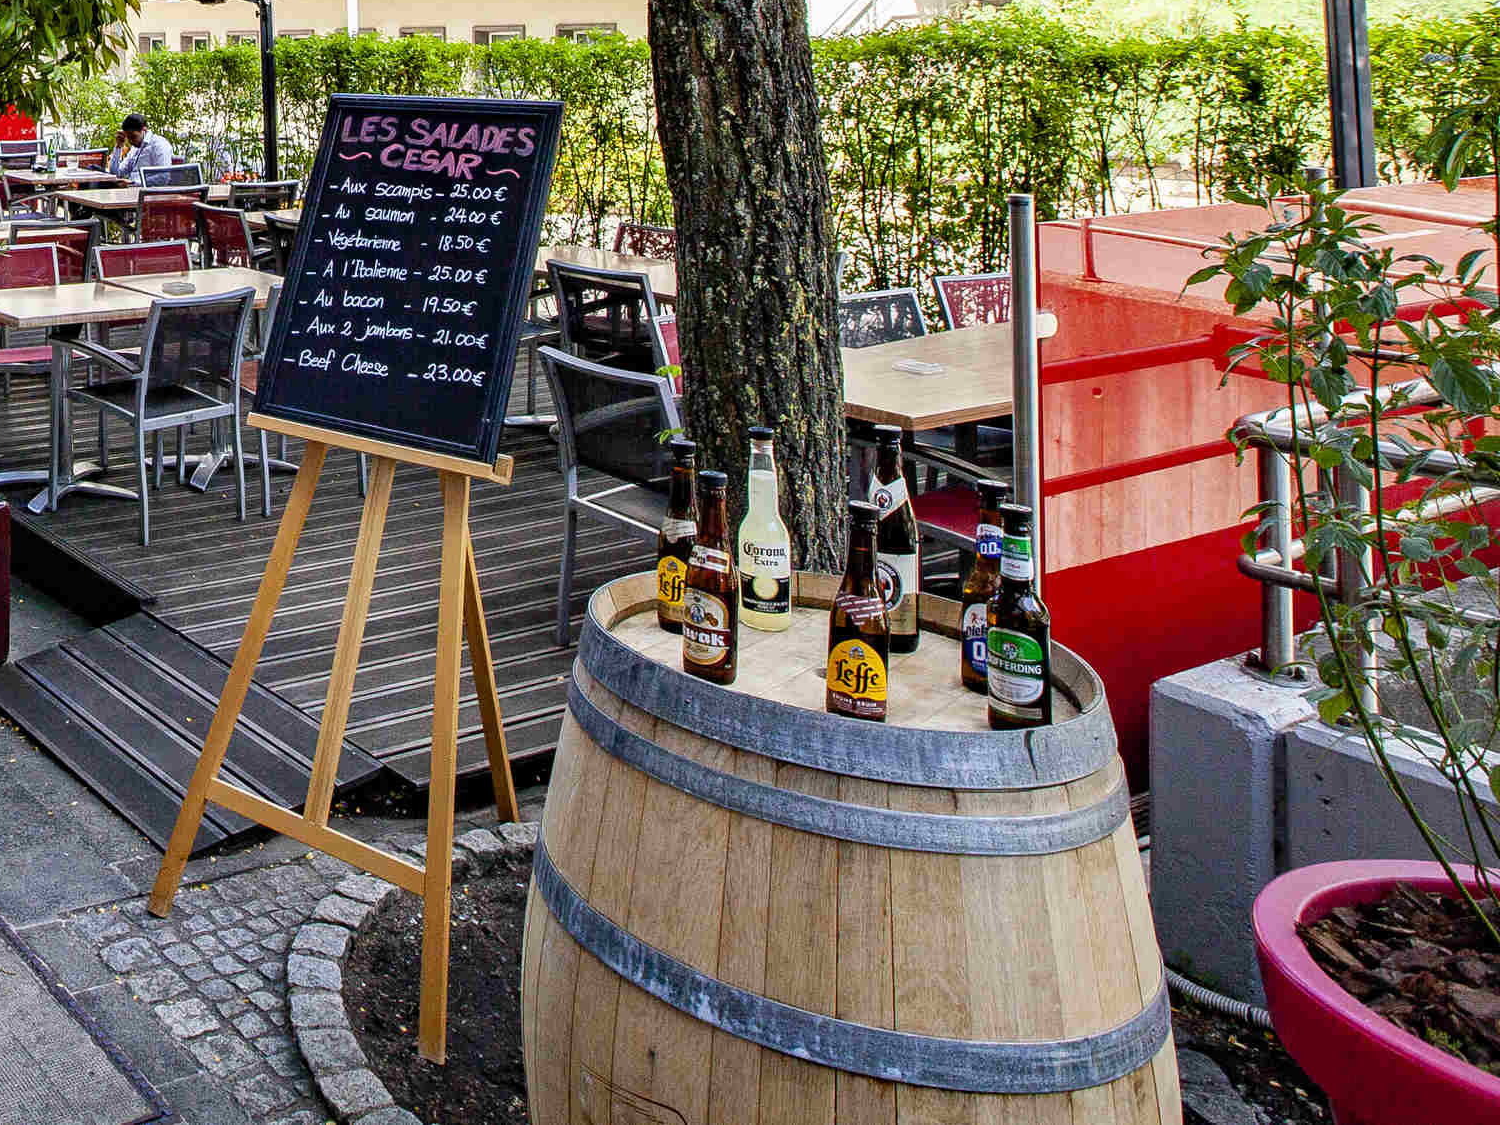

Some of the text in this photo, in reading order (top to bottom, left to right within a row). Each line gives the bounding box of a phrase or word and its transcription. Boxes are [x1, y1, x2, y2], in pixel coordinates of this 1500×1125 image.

[341, 116, 536, 157] LES SALADES
[379, 143, 483, 180] CESAR
[340, 177, 367, 194] Aux
[335, 203, 350, 219] Au
[313, 288, 332, 307] Au
[343, 290, 385, 309] bacon
[306, 315, 335, 337] Aux
[341, 321, 352, 336] 2
[298, 348, 335, 371] Beef
[742, 541, 787, 558] Corona
[753, 555, 780, 567] Extra
[659, 573, 686, 602] Leff
[835, 658, 880, 694] Leffe
